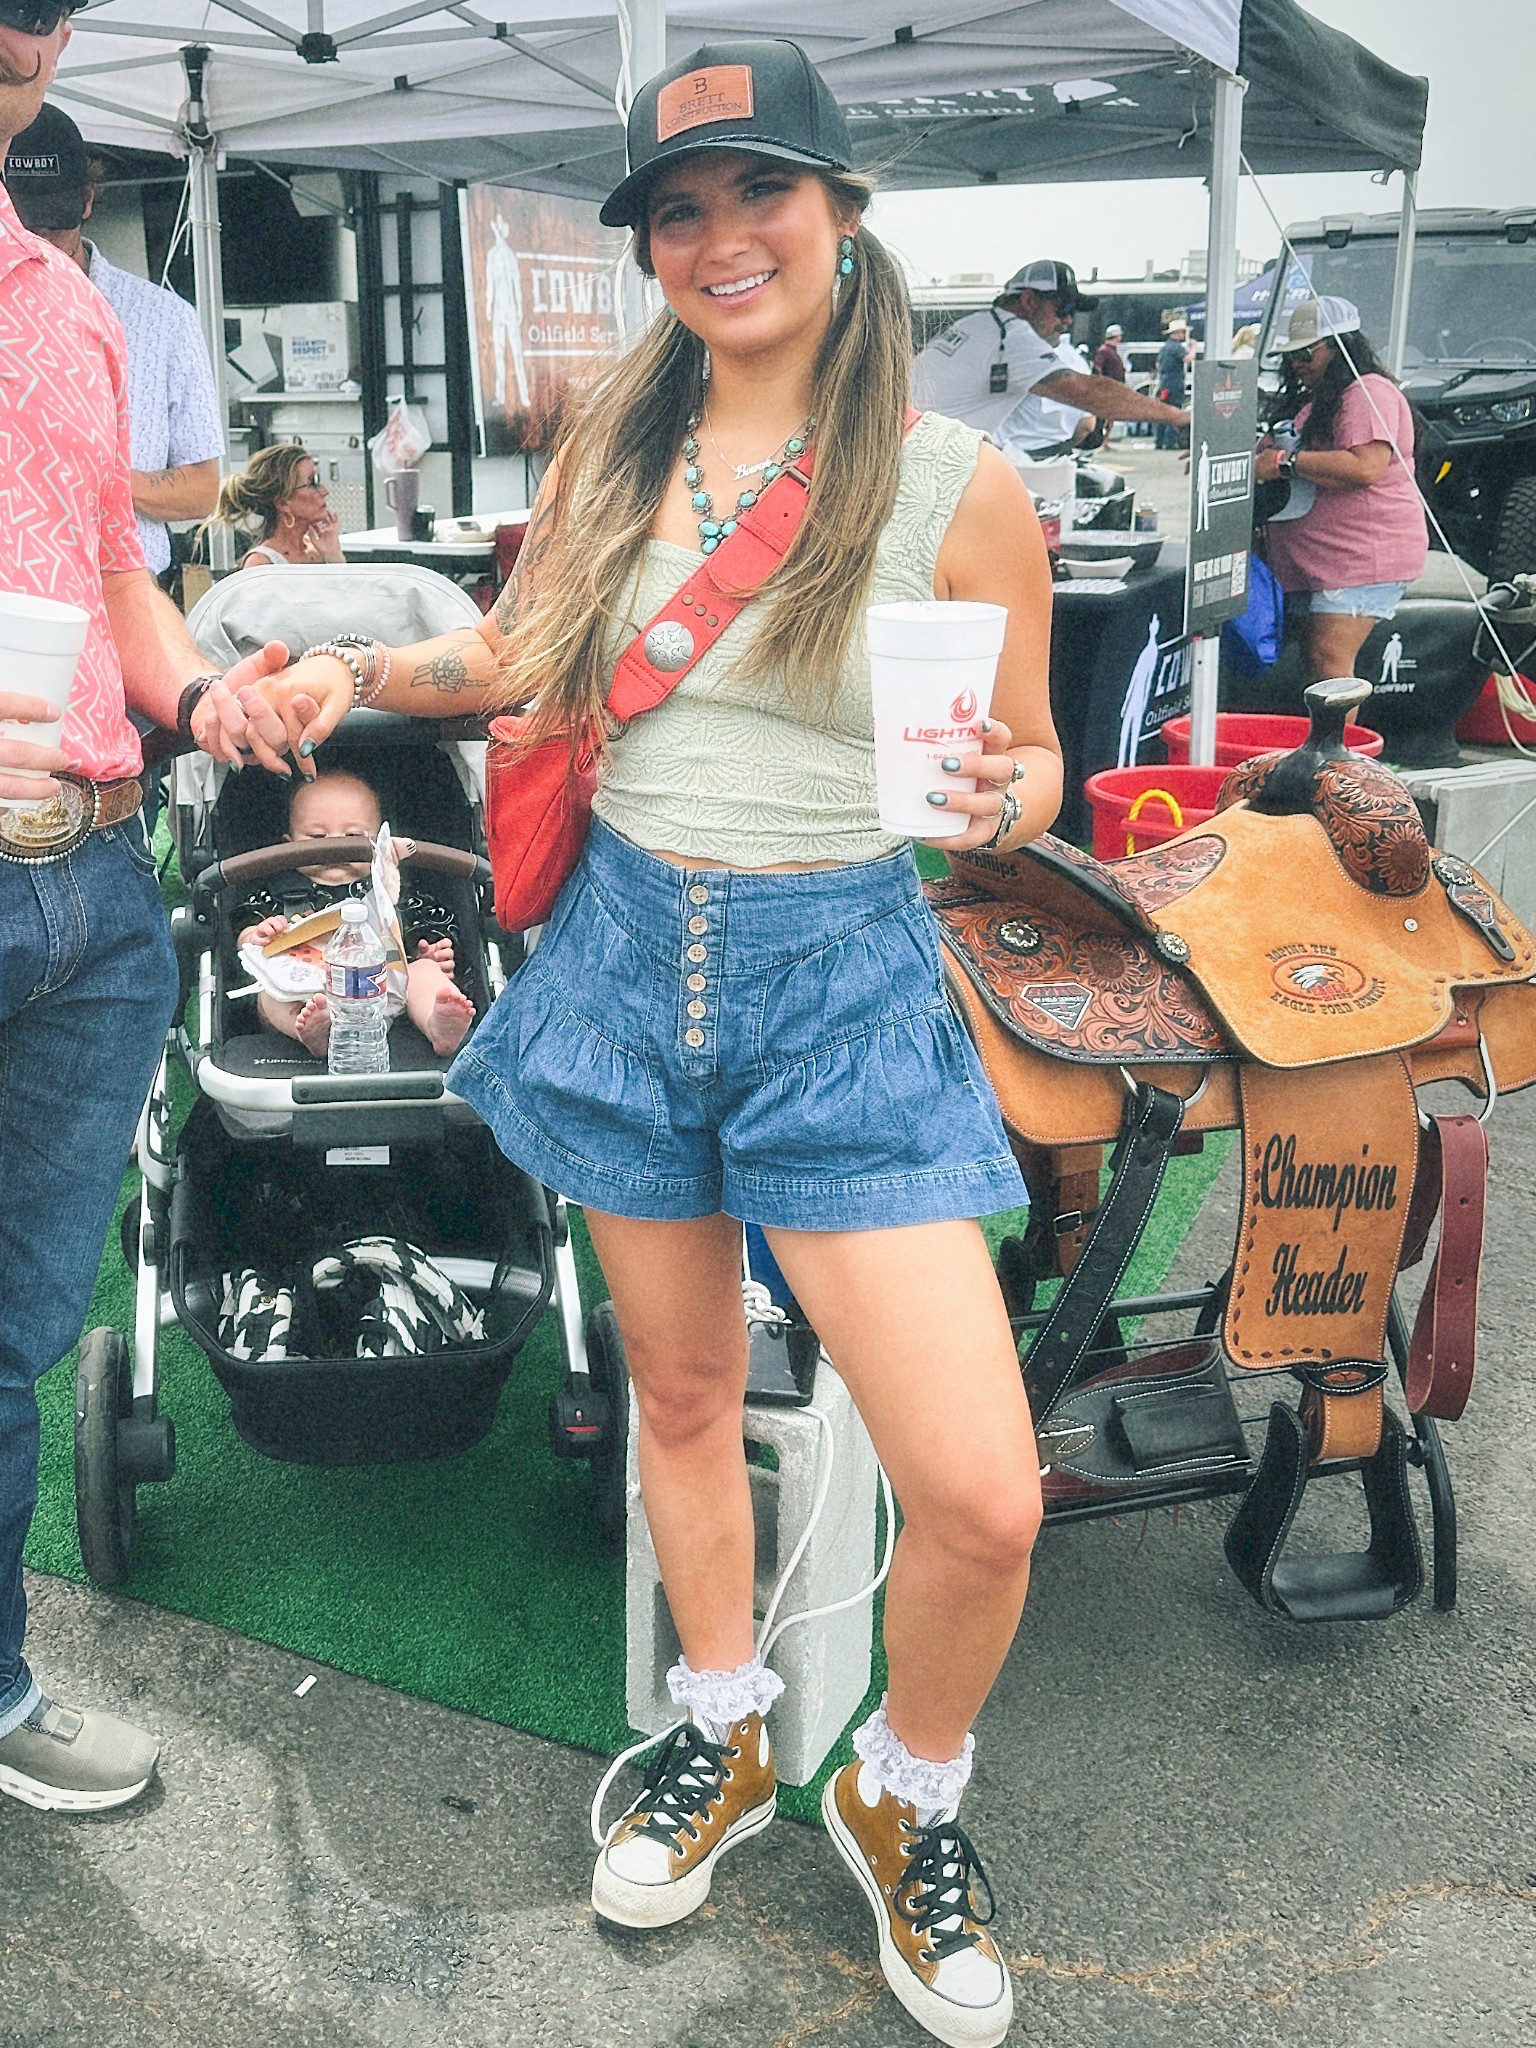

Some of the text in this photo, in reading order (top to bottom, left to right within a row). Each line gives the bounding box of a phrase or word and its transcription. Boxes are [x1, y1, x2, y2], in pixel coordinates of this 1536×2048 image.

[693, 77, 708, 95] B
[680, 93, 725, 113] BRETT
[665, 102, 742, 129] CONSTRUCTION
[9, 157, 54, 168] COWBOY
[531, 268, 613, 314] COWB
[528, 325, 585, 343] Oilfield
[1211, 458, 1248, 485] COWBOY
[1155, 643, 1193, 697] COW
[1373, 683, 1415, 694] COWBOY
[904, 727, 977, 745] LIGHTN
[1265, 943, 1338, 962] ROPING THE
[1270, 977, 1386, 1015] EAGLE FORD BENEFIT
[1261, 1133, 1397, 1232] Champion
[1265, 1243, 1368, 1317] Header
